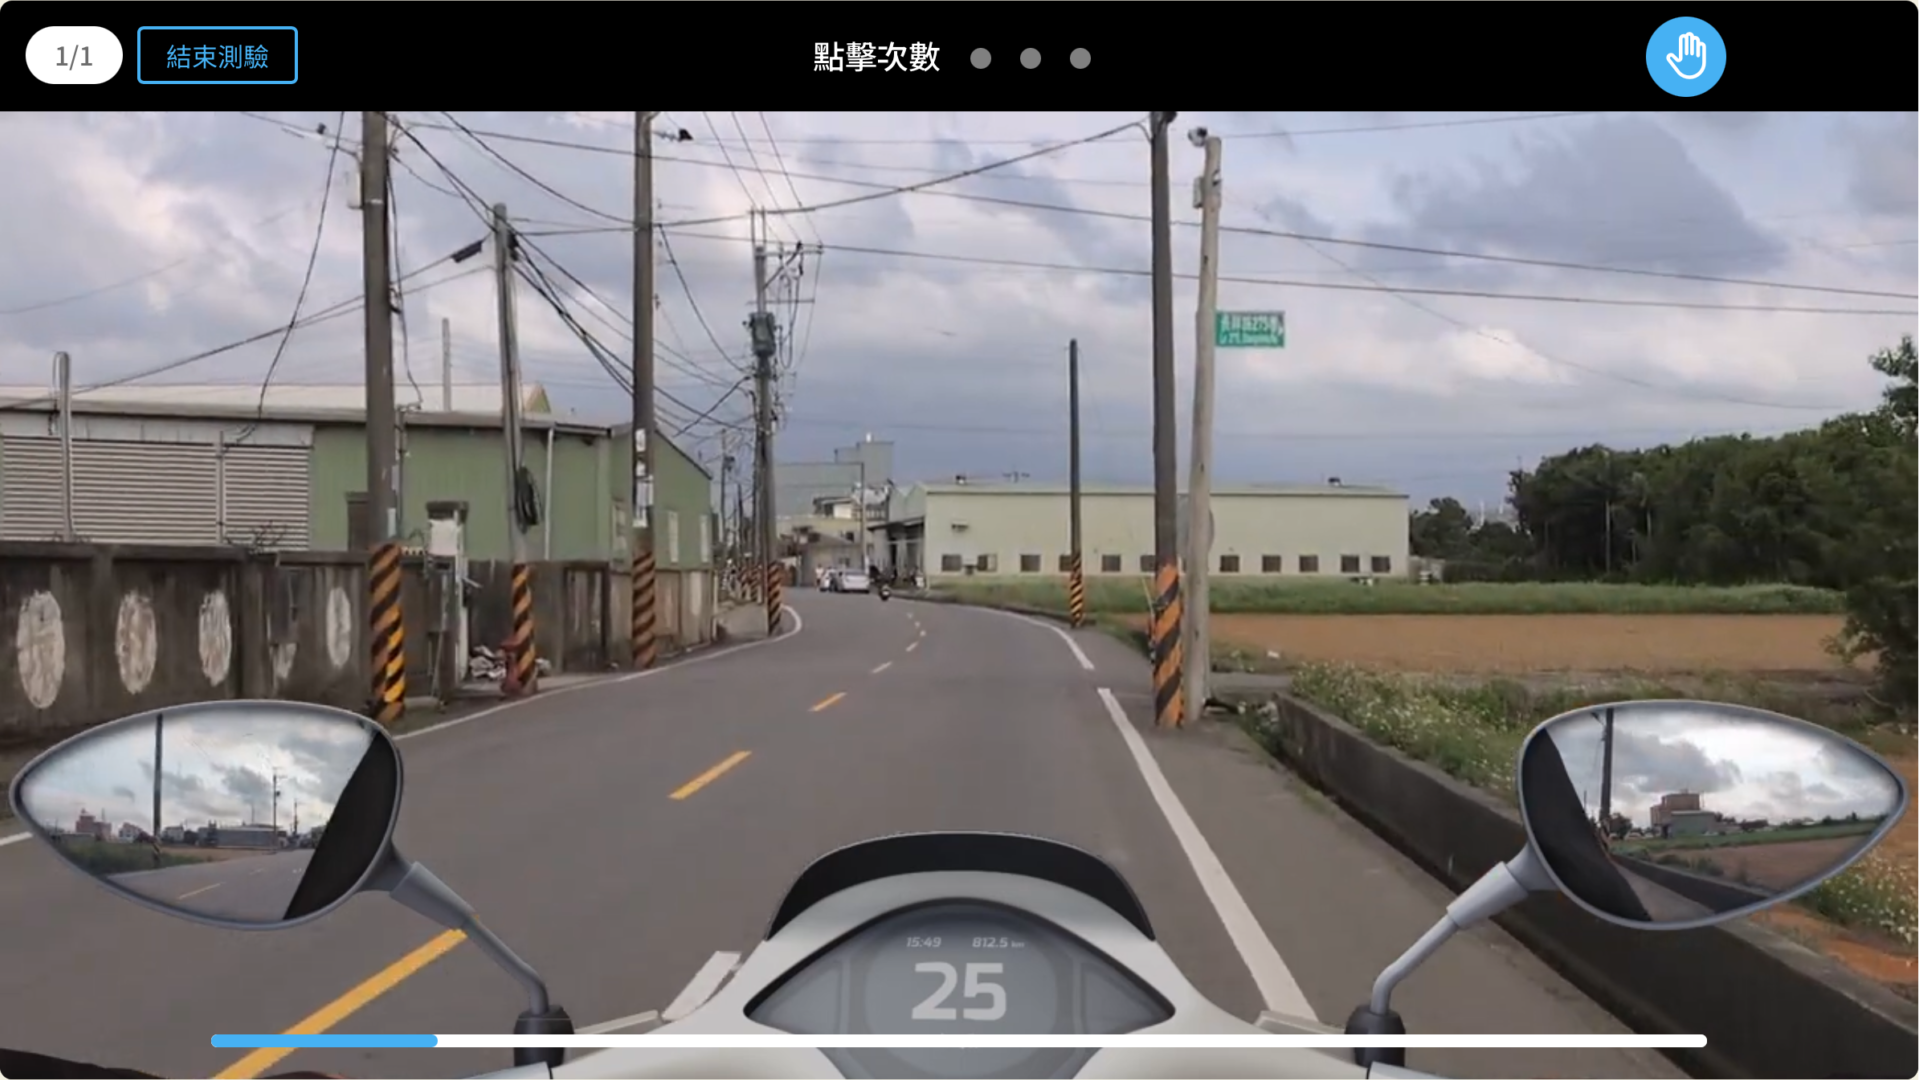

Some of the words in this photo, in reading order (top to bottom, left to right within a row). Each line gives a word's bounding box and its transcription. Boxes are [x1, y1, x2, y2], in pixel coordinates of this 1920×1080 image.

[906, 937, 942, 948] 15:49
[972, 937, 1009, 948] 812.5
[1011, 940, 1025, 948] km
[912, 961, 1007, 1021] 25
